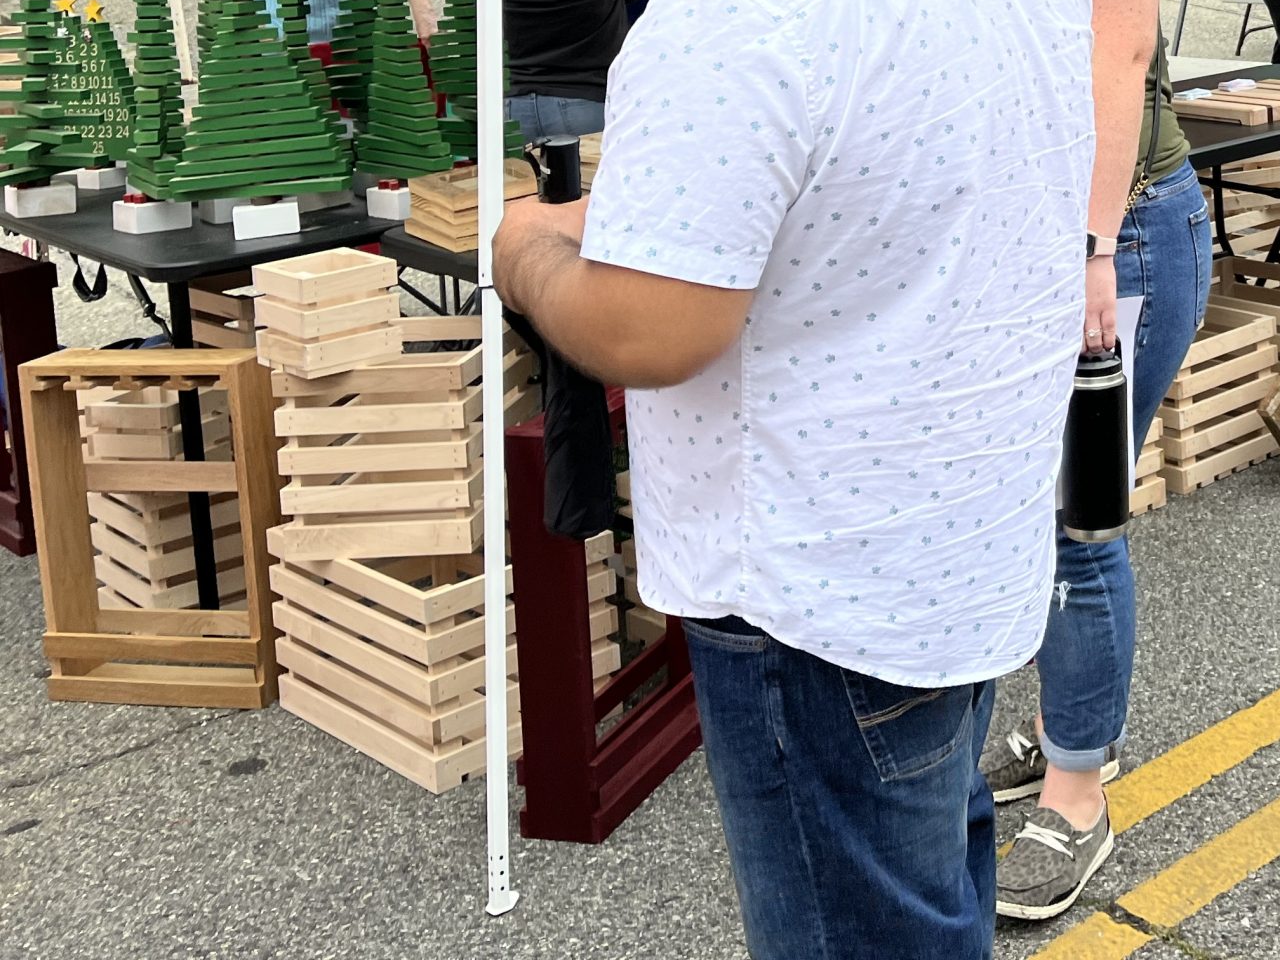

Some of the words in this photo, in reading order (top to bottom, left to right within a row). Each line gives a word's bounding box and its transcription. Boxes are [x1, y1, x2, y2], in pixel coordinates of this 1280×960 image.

[90, 43, 98, 56] 3
[90, 60, 97, 72] 6
[88, 76, 99, 89] 10
[101, 76, 113, 89] 11
[95, 92, 107, 105] 14
[109, 92, 120, 105] 15
[116, 108, 128, 121] 20
[81, 126, 95, 138] 22
[98, 125, 112, 138] 23
[116, 125, 129, 138] 24
[93, 141, 104, 154] 25
